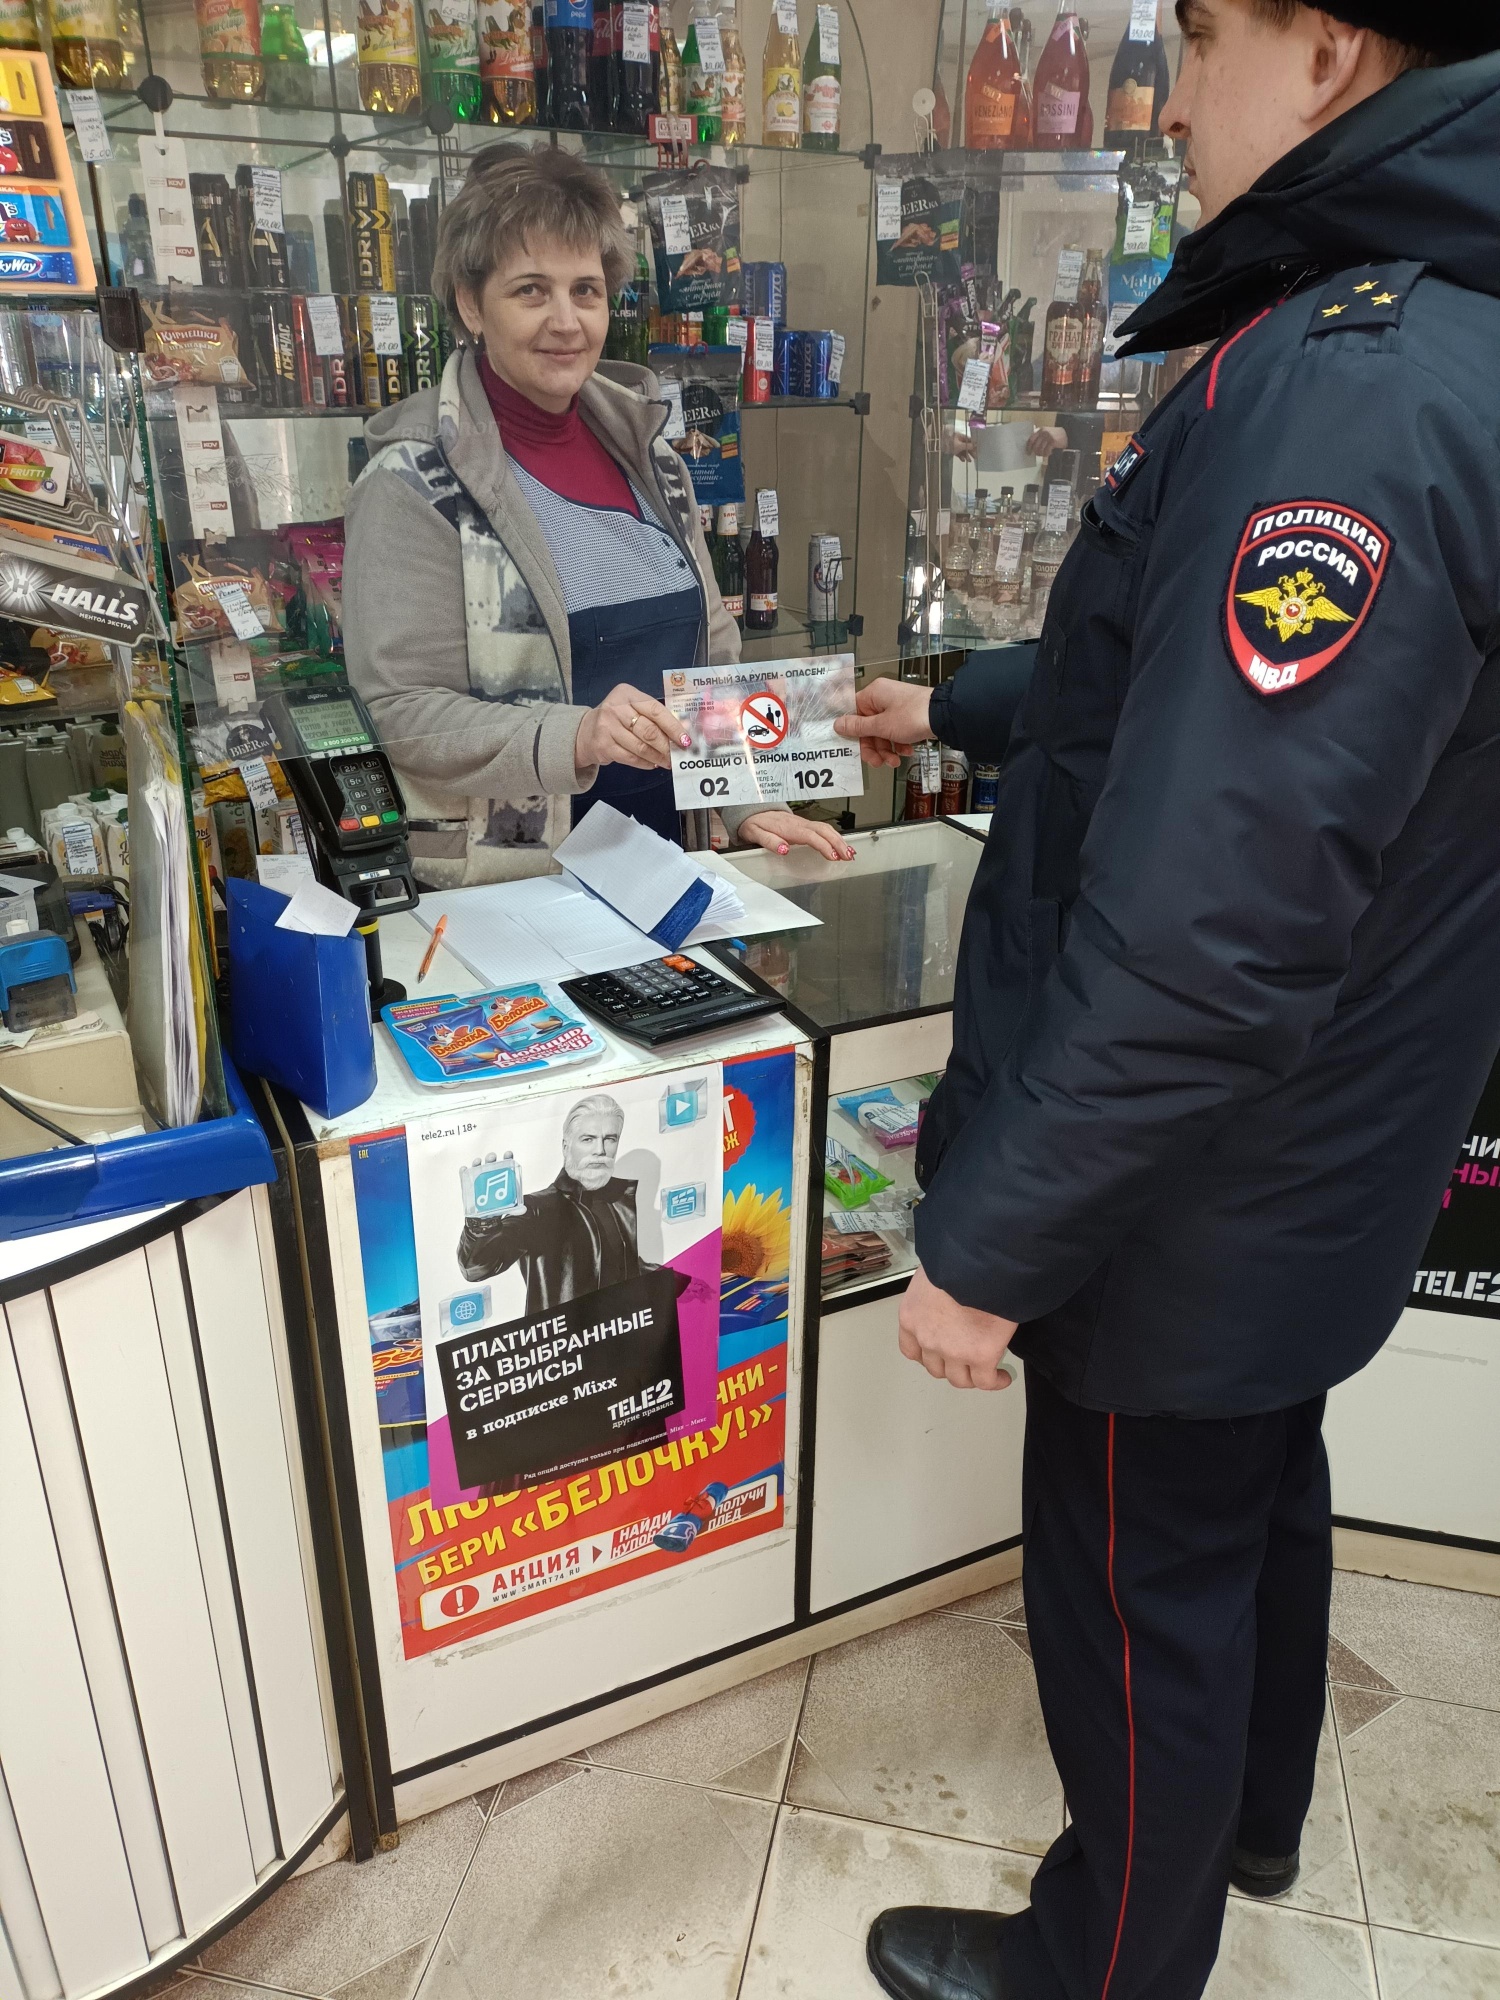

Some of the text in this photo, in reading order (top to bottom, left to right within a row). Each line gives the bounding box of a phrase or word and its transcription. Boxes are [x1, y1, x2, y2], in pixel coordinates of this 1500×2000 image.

[1040, 104, 1075, 117] ROSSINI
[353, 180, 374, 277] DRIVE
[610, 309, 637, 318] FLASH
[771, 273, 782, 317] kinza
[10, 467, 45, 478] FRUTTI
[1252, 509, 1382, 562] ПОЛИЦИЯ
[1257, 540, 1359, 586] РОССИЯ
[79, 612, 132, 630] МЕНТОЛ ЭКСТРА
[693, 674, 733, 686] ПЬЯНЫЙ
[735, 674, 747, 683] ЗА
[750, 673, 778, 682] РУЛЕМ
[785, 667, 826, 678] ОПАСЕН!
[1248, 654, 1299, 690] МВД
[679, 758, 731, 770] СООБЩИ
[733, 757, 742, 766] О
[792, 748, 853, 761] ВОДИТЕЛЕ:
[794, 768, 833, 790] 102
[699, 777, 729, 797] 02
[421, 1123, 477, 1141] tele2.ru 18+
[452, 1314, 568, 1369] ПЛАТИТЕ
[456, 1308, 654, 1391] ЗА ВЫБРАННЫЕ
[460, 1354, 583, 1412] СЕРВИСЫ
[607, 1379, 673, 1421] TELE2
[466, 1377, 617, 1440] в подписке Mixx
[612, 1400, 674, 1429] другие правила
[523, 1472, 536, 1480] Ряд
[537, 1466, 558, 1476] опций
[559, 1456, 589, 1470] доступен
[590, 1450, 611, 1460] только
[612, 1445, 625, 1454] при
[612, 1508, 742, 1558] КУПОН ПЛЕД
[619, 1486, 764, 1542] НАЙДИ ПОЛУЧИ
[417, 1526, 506, 1585] БЕРИ
[492, 1547, 580, 1593] АКЦИЯ
